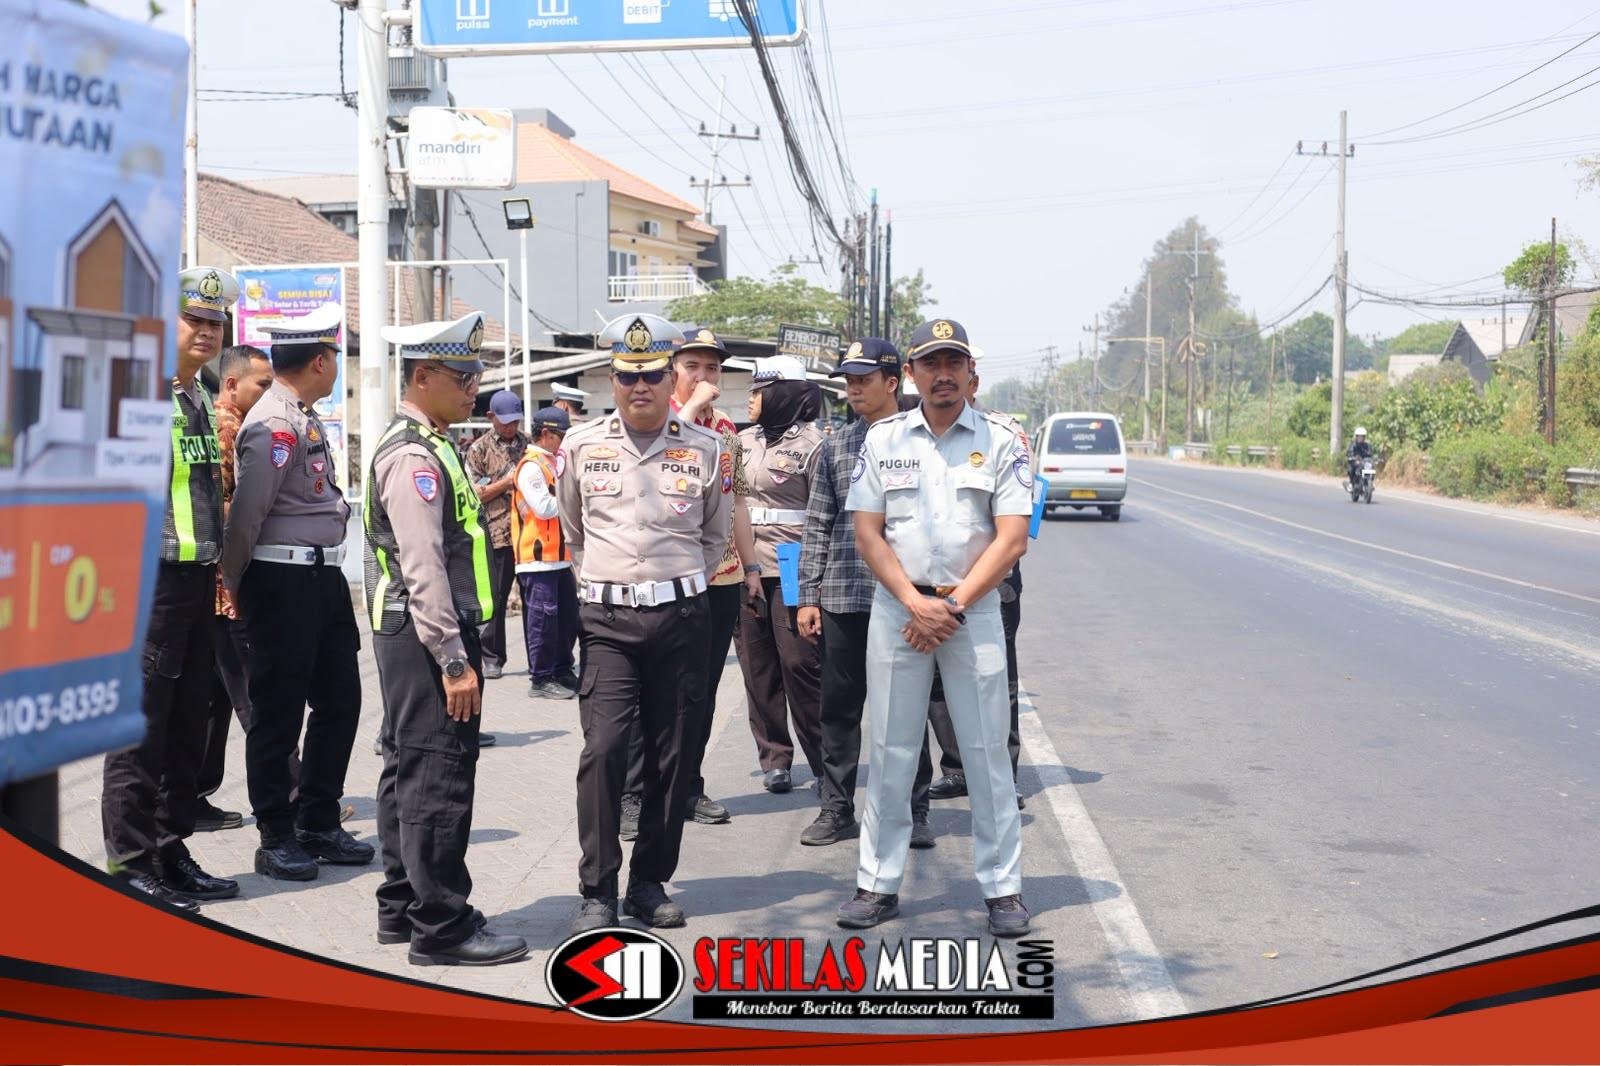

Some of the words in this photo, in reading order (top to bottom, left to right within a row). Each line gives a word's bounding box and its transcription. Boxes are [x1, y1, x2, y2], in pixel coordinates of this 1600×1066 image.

[627, 6, 660, 16] DEBIT
[456, 20, 490, 32] pulsa
[528, 16, 578, 29] payment
[25, 64, 124, 111] WARGA
[419, 141, 481, 154] mandiri
[419, 155, 447, 166] atm
[775, 449, 802, 460] POLRI
[584, 462, 620, 473] HERU
[662, 463, 700, 476] POLRI
[879, 459, 920, 470] PUGUH
[64, 555, 97, 622] 0
